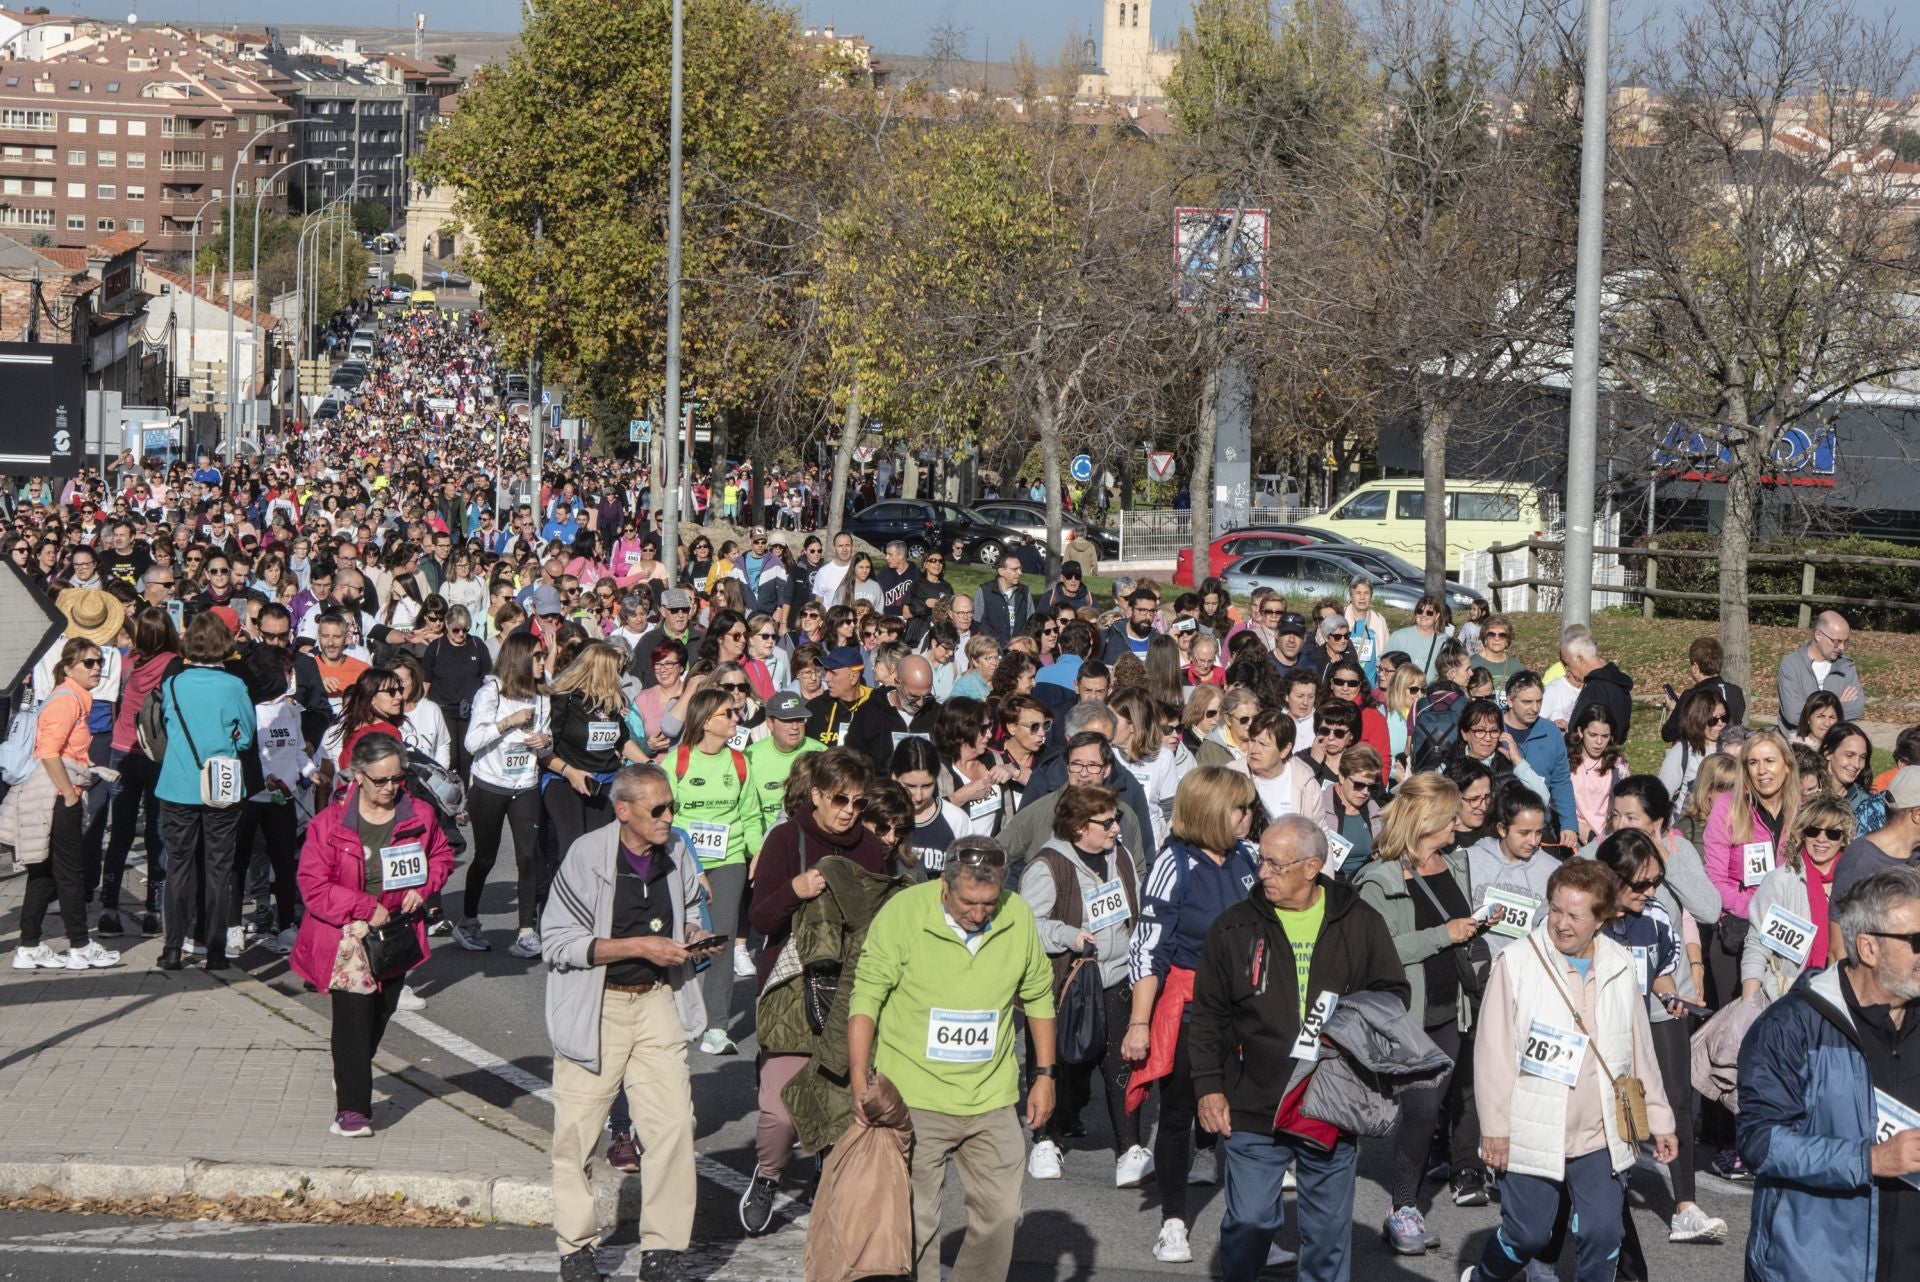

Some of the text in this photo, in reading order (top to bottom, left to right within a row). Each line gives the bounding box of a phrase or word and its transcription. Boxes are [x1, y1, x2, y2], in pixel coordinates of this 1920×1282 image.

[270, 728, 290, 738] 1985
[592, 731, 617, 742] 8702
[820, 731, 840, 742] STA
[506, 755, 530, 767] 8701
[220, 764, 232, 798] 7607
[691, 832, 722, 847] 6418
[390, 857, 421, 878] 2619
[1091, 893, 1123, 918] 6768
[1766, 920, 1805, 950] 2502
[1298, 1001, 1327, 1048] 2621
[937, 1026, 990, 1047] 6404
